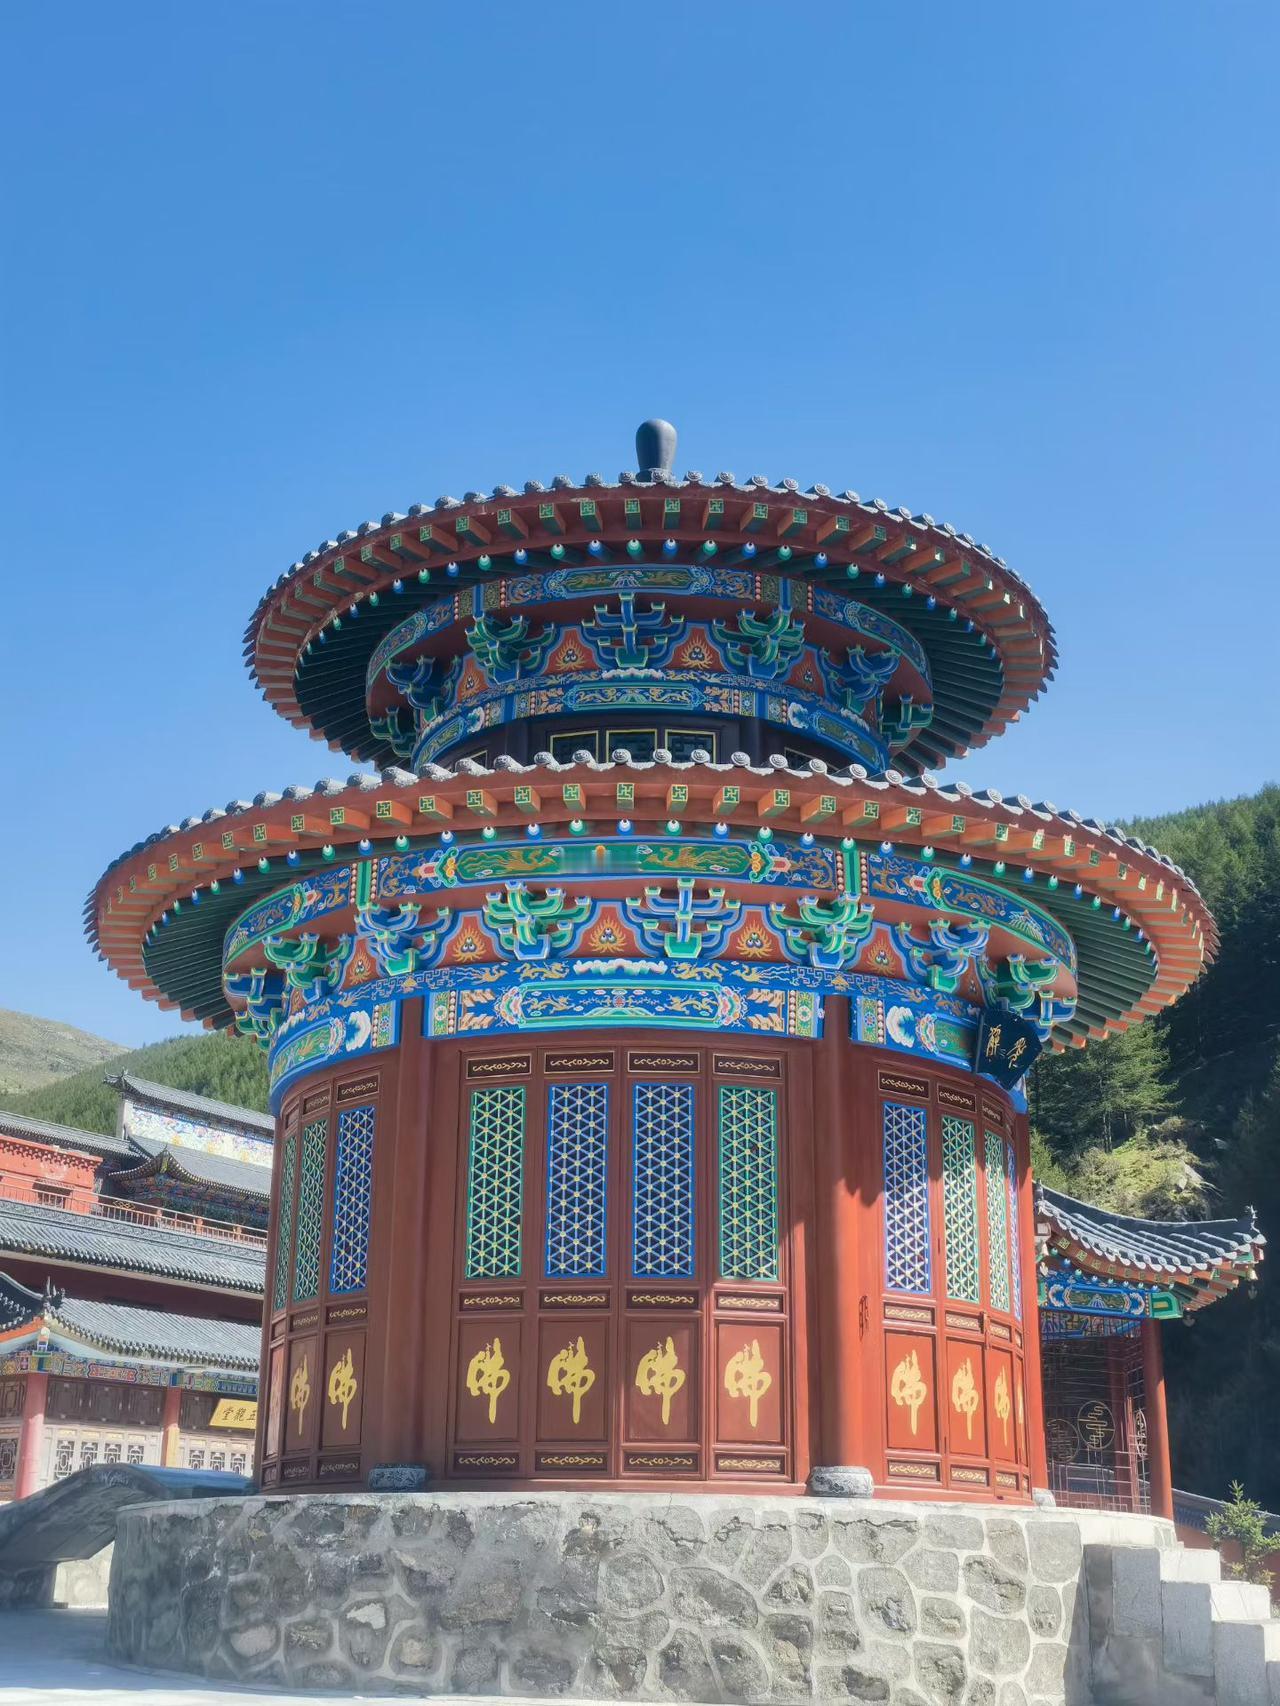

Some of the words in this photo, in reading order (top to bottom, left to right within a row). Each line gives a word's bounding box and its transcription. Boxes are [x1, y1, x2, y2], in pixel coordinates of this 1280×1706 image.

[328, 1347, 358, 1430] 佛
[466, 1337, 511, 1424] 佛
[547, 1336, 595, 1424] 佛
[635, 1336, 686, 1425] 佛
[724, 1339, 772, 1428] 佛
[891, 1349, 927, 1436] 佛
[952, 1357, 979, 1441] 佛
